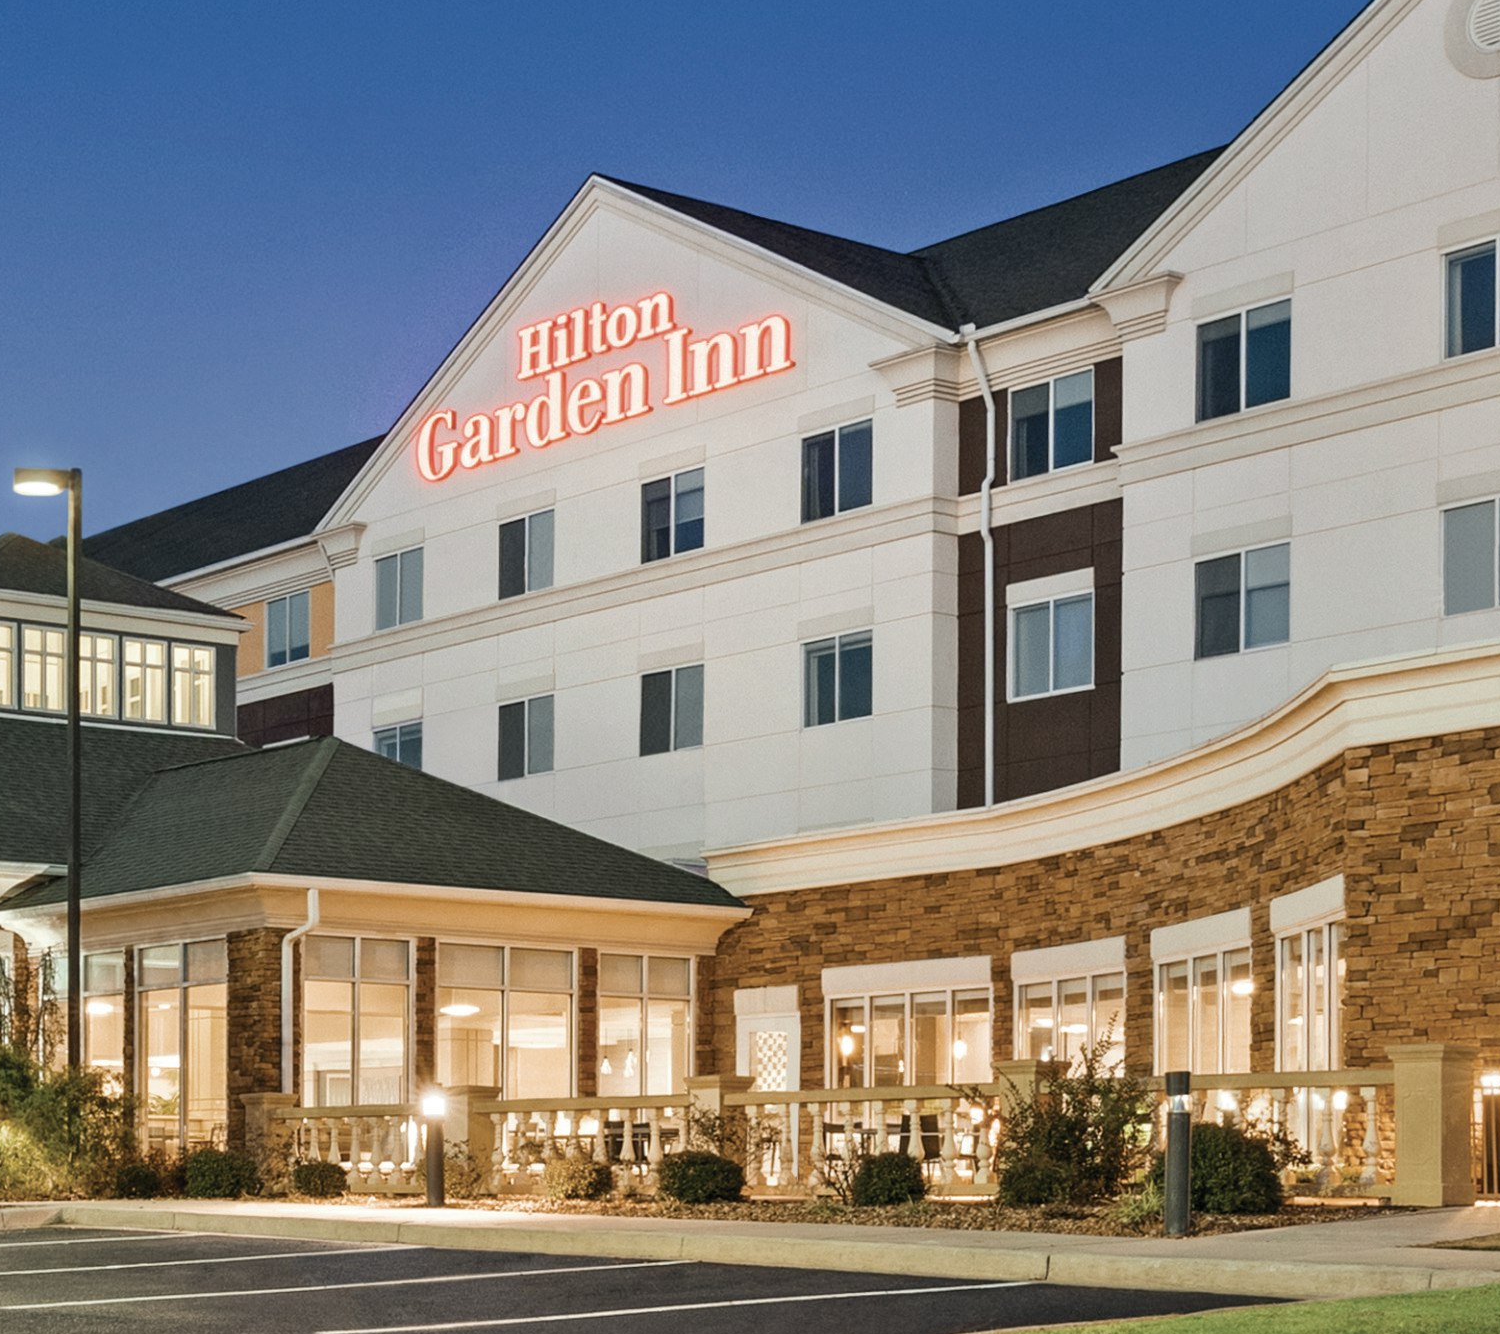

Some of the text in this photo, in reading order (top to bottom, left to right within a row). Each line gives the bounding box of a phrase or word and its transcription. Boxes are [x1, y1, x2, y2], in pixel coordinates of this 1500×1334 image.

[415, 313, 796, 483] Garden Inn
[516, 290, 677, 381] Hilton
